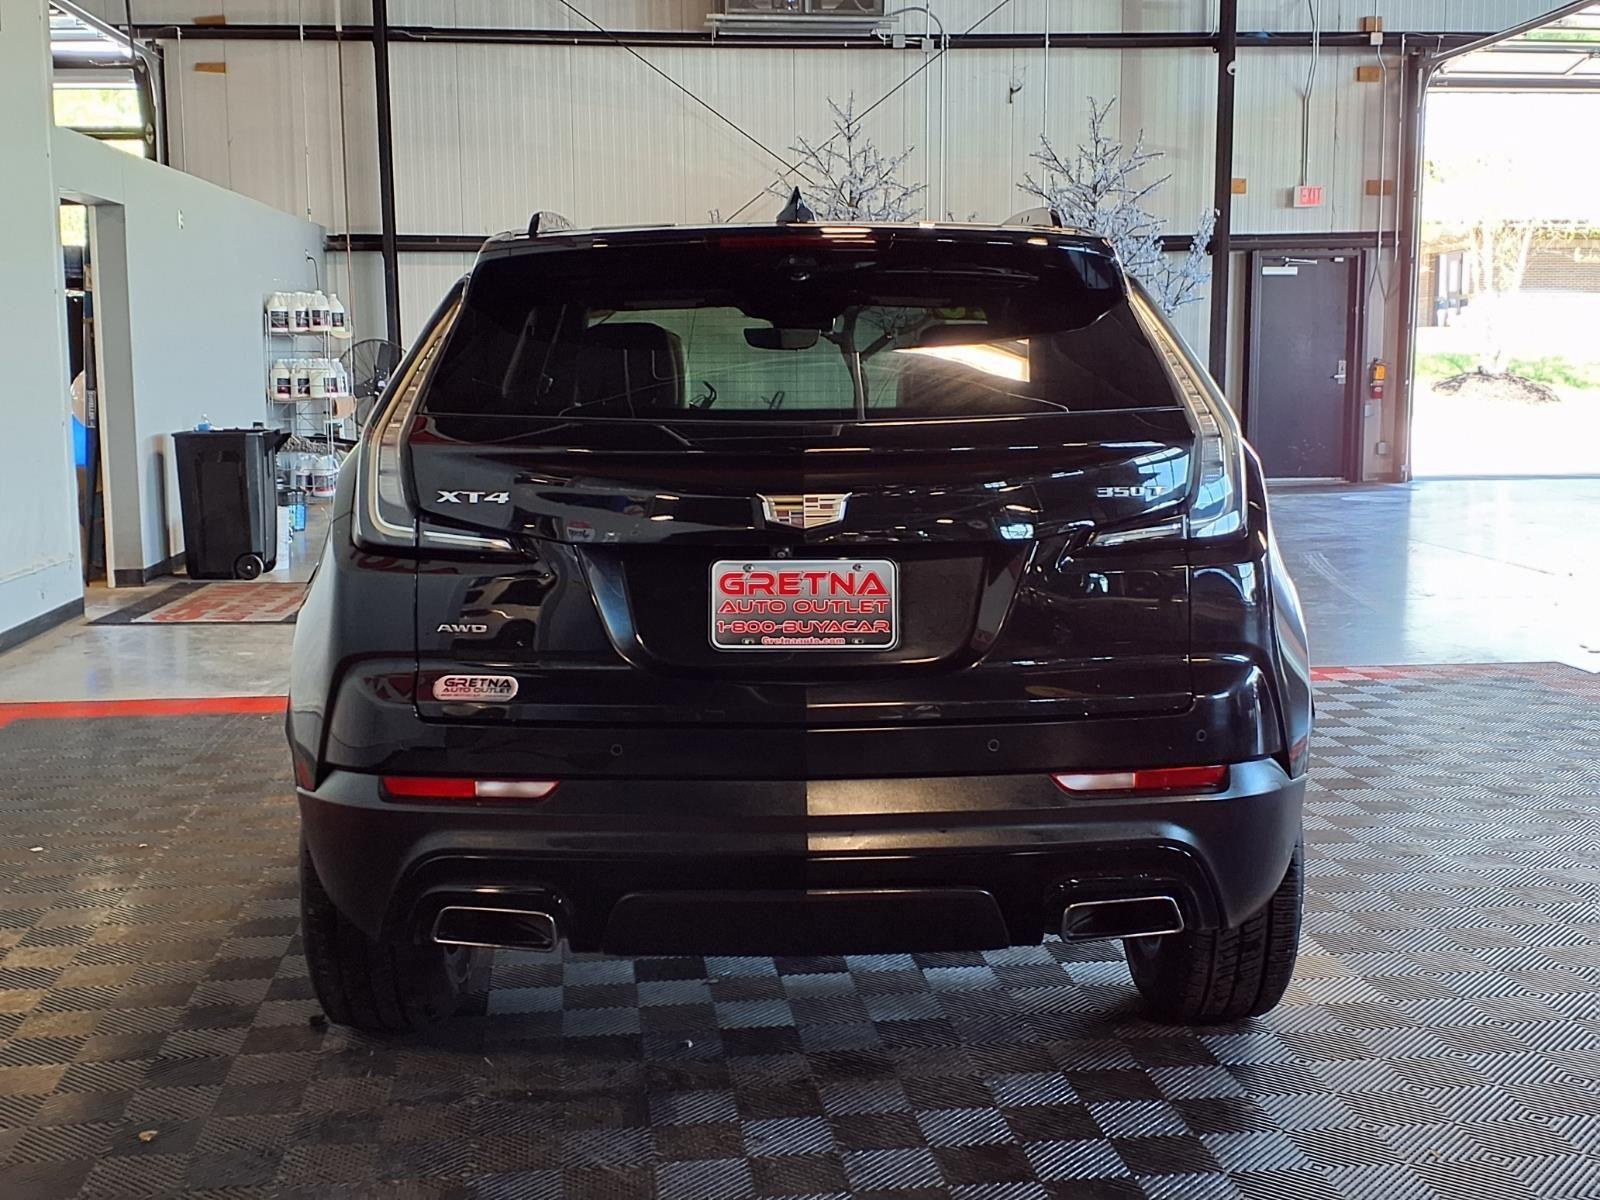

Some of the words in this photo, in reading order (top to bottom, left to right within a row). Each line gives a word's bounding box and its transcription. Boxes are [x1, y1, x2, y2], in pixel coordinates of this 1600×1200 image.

[1299, 187, 1322, 203] EXIT
[436, 490, 510, 504] XT4
[1096, 486, 1165, 498] 350T
[719, 572, 888, 595] GRETNA
[718, 600, 786, 613] AUTO
[793, 600, 888, 613] OUTLET
[437, 624, 488, 633] AWD
[717, 620, 890, 633] 1-800-BUYACAR
[444, 678, 512, 687] GRETNA
